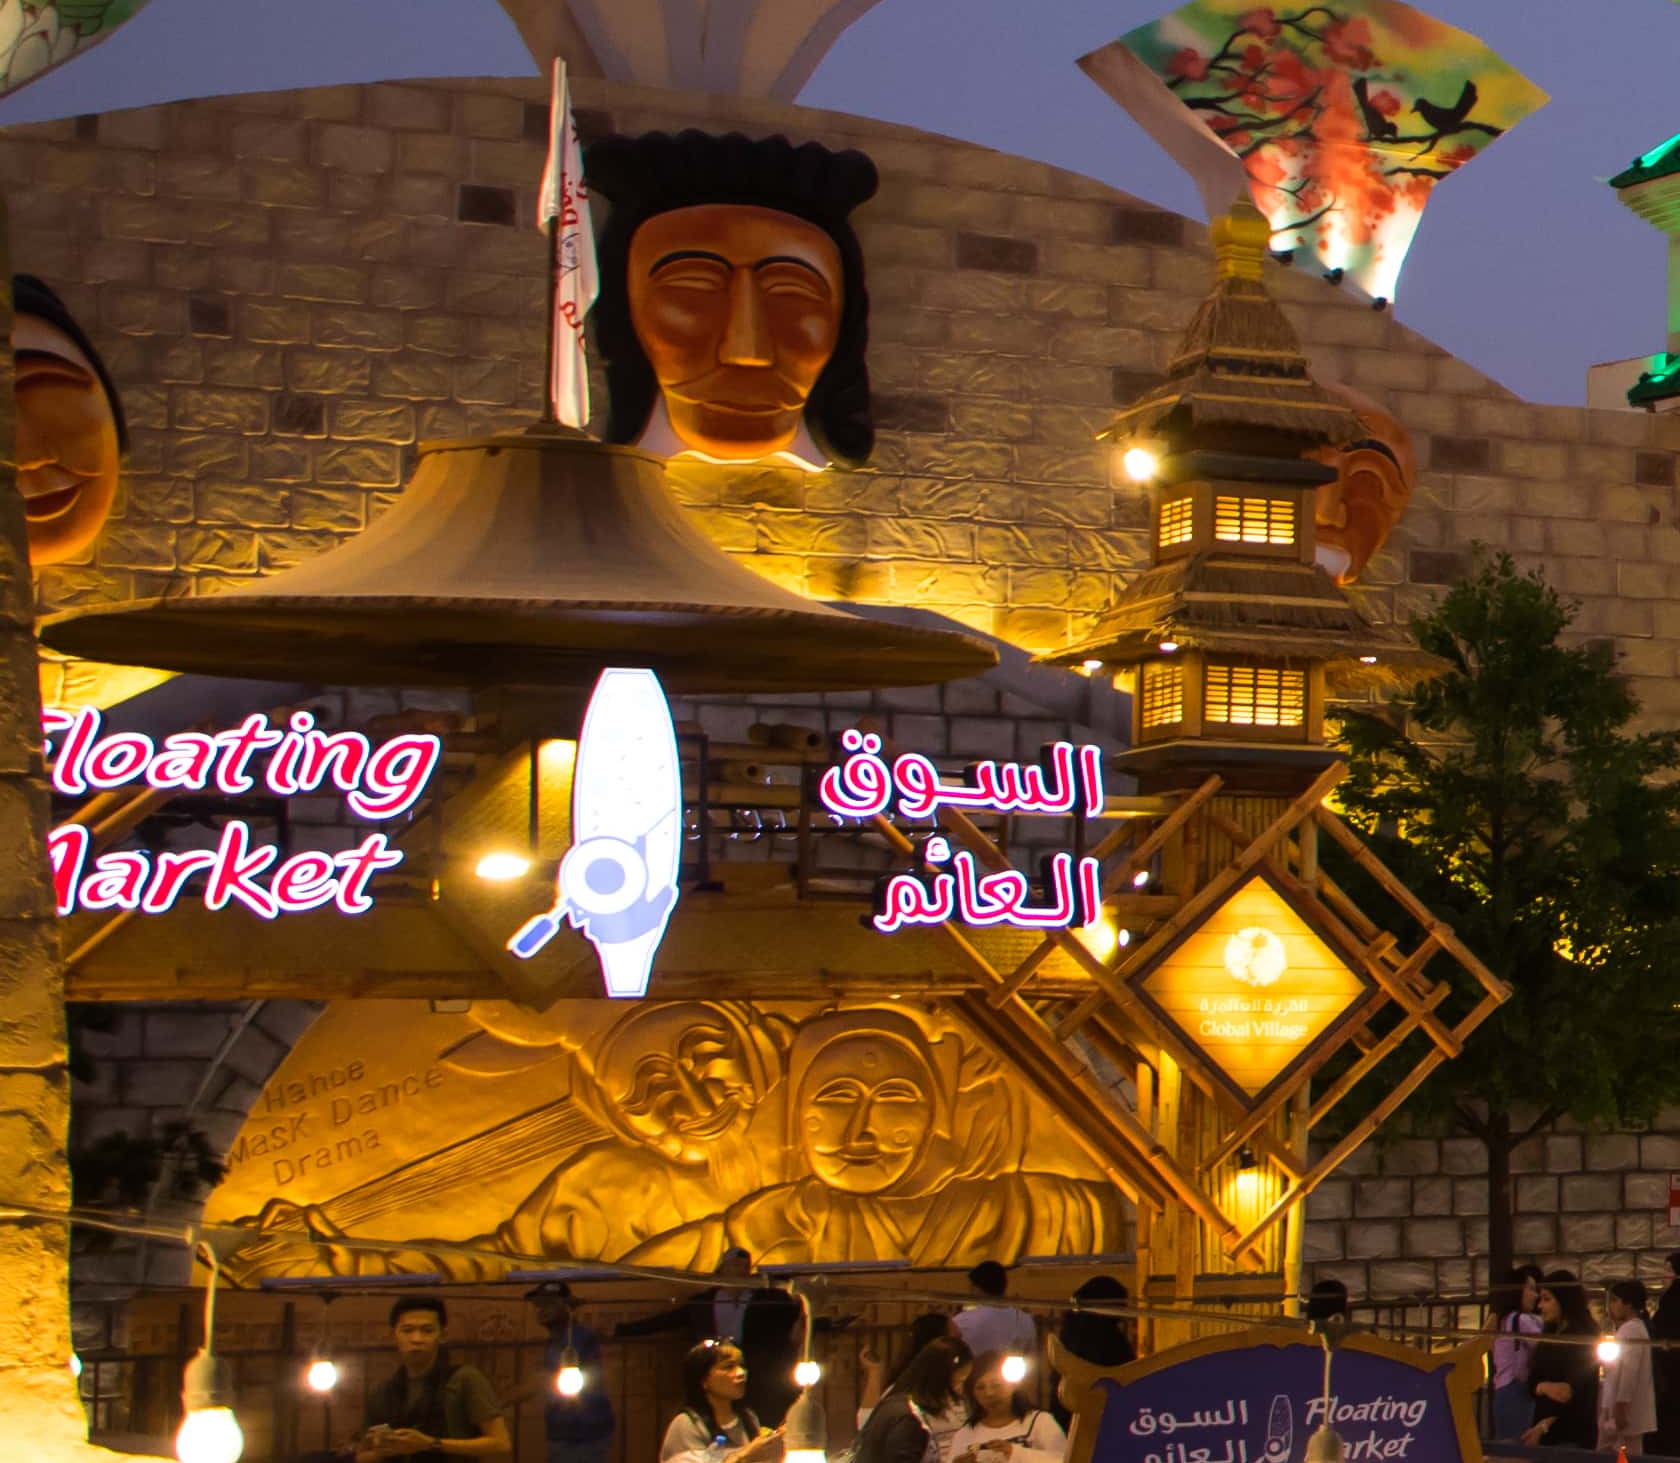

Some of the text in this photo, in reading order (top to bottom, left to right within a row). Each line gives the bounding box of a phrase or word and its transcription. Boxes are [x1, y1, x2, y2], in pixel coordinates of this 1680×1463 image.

[820, 729, 1104, 819] السوق
[873, 836, 1102, 932] العائم
[1199, 1020, 1308, 1040] Global Village
[331, 1066, 444, 1128] Dance
[273, 1128, 383, 1187] Drama
[1129, 1400, 1249, 1435] السوق
[1305, 1395, 1428, 1428] Floating
[1342, 1430, 1415, 1462] arket
